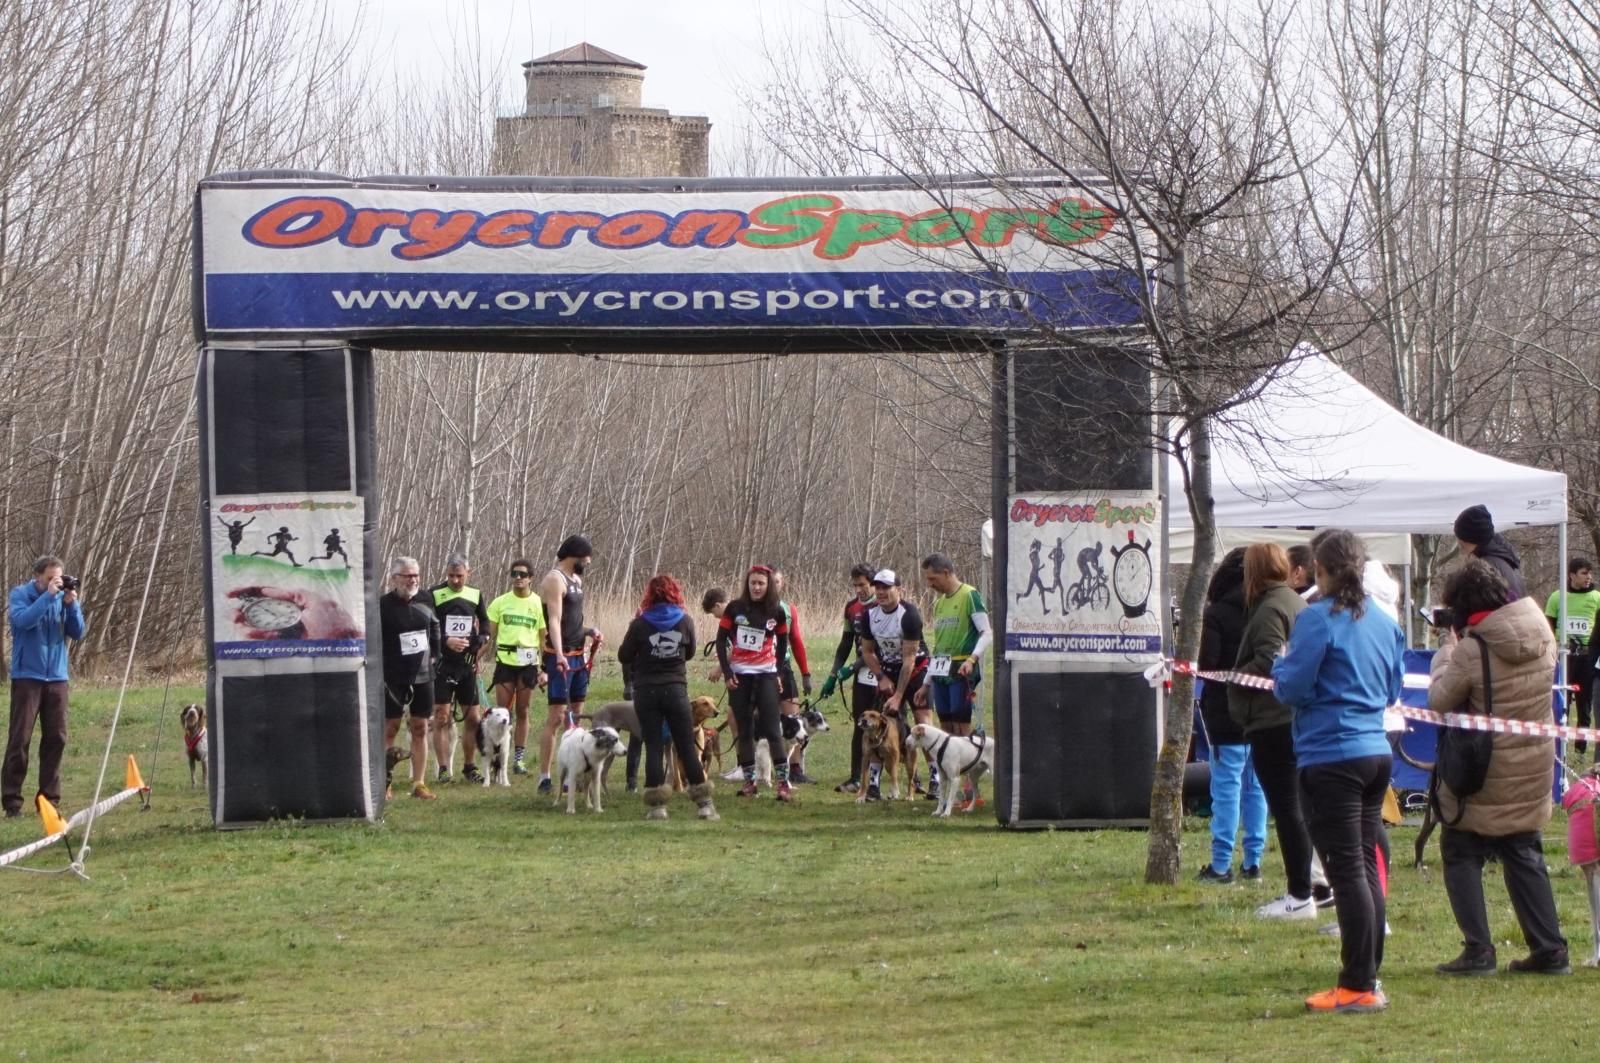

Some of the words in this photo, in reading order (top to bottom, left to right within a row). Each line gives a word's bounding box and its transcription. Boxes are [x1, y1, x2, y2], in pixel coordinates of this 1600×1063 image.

[332, 284, 1028, 316] www.orycronsport.com
[452, 622, 466, 631] 20
[1570, 622, 1587, 630] 116
[411, 638, 418, 648] 3
[742, 633, 757, 645] 13
[1020, 636, 1147, 652] www.orycronsport.com
[224, 645, 360, 655] www.orycronsport.com
[882, 641, 896, 649] 12
[526, 651, 532, 659] 6
[935, 660, 945, 670] 11
[867, 671, 874, 679] 5
